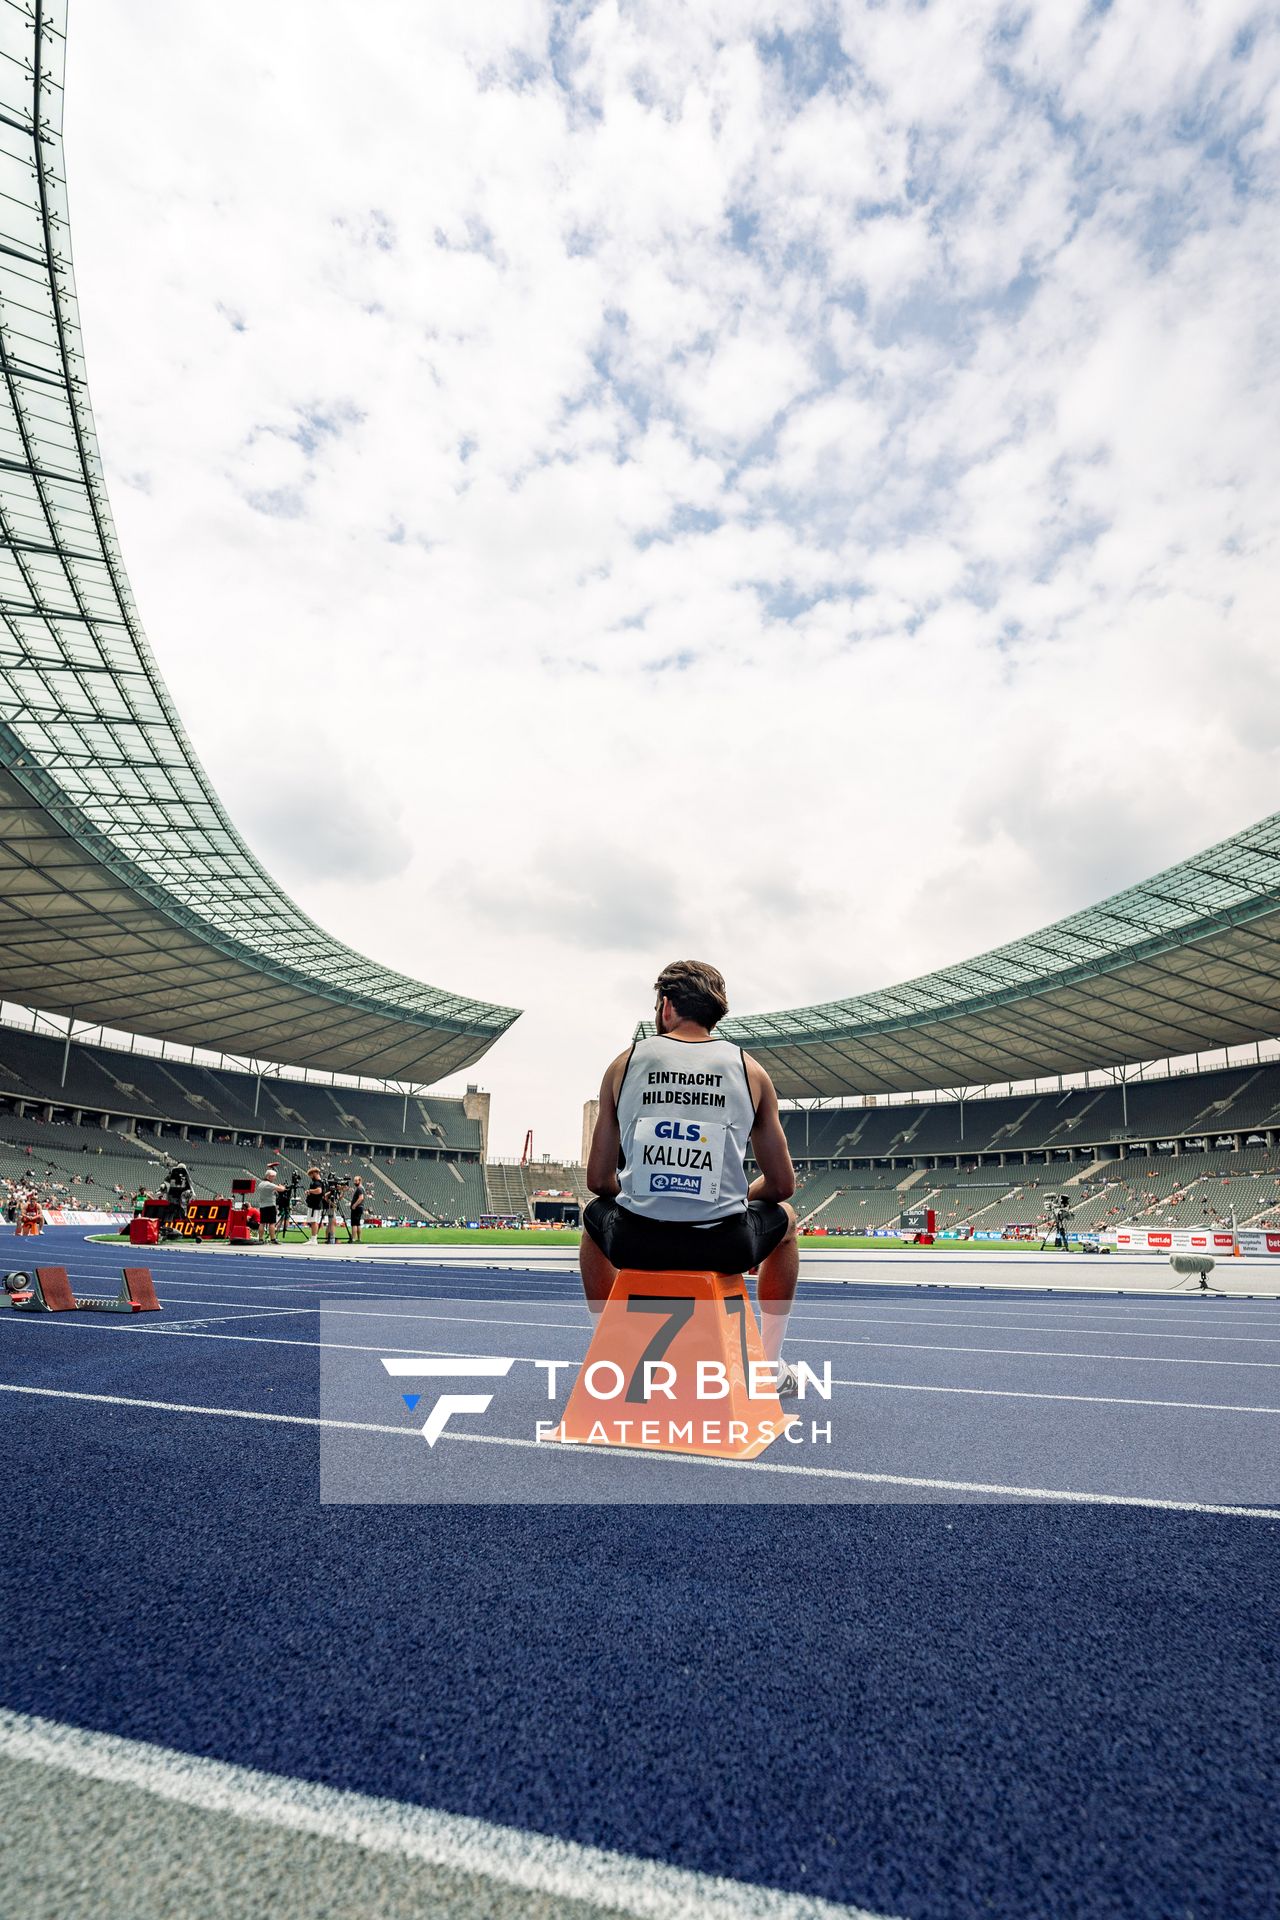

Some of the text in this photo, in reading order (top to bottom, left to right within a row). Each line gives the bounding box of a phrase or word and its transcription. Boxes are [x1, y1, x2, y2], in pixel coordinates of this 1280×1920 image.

[648, 1071, 723, 1088] EINTRACHT
[642, 1091, 726, 1108] HILDESHEIM
[643, 1145, 713, 1172] KALUZA
[670, 1177, 700, 1188] PLAN
[187, 1206, 219, 1219] 0.0
[215, 1222, 226, 1235] H
[1149, 1236, 1171, 1244] bett1.de
[625, 1294, 695, 1404] 7
[723, 1294, 752, 1400] 7
